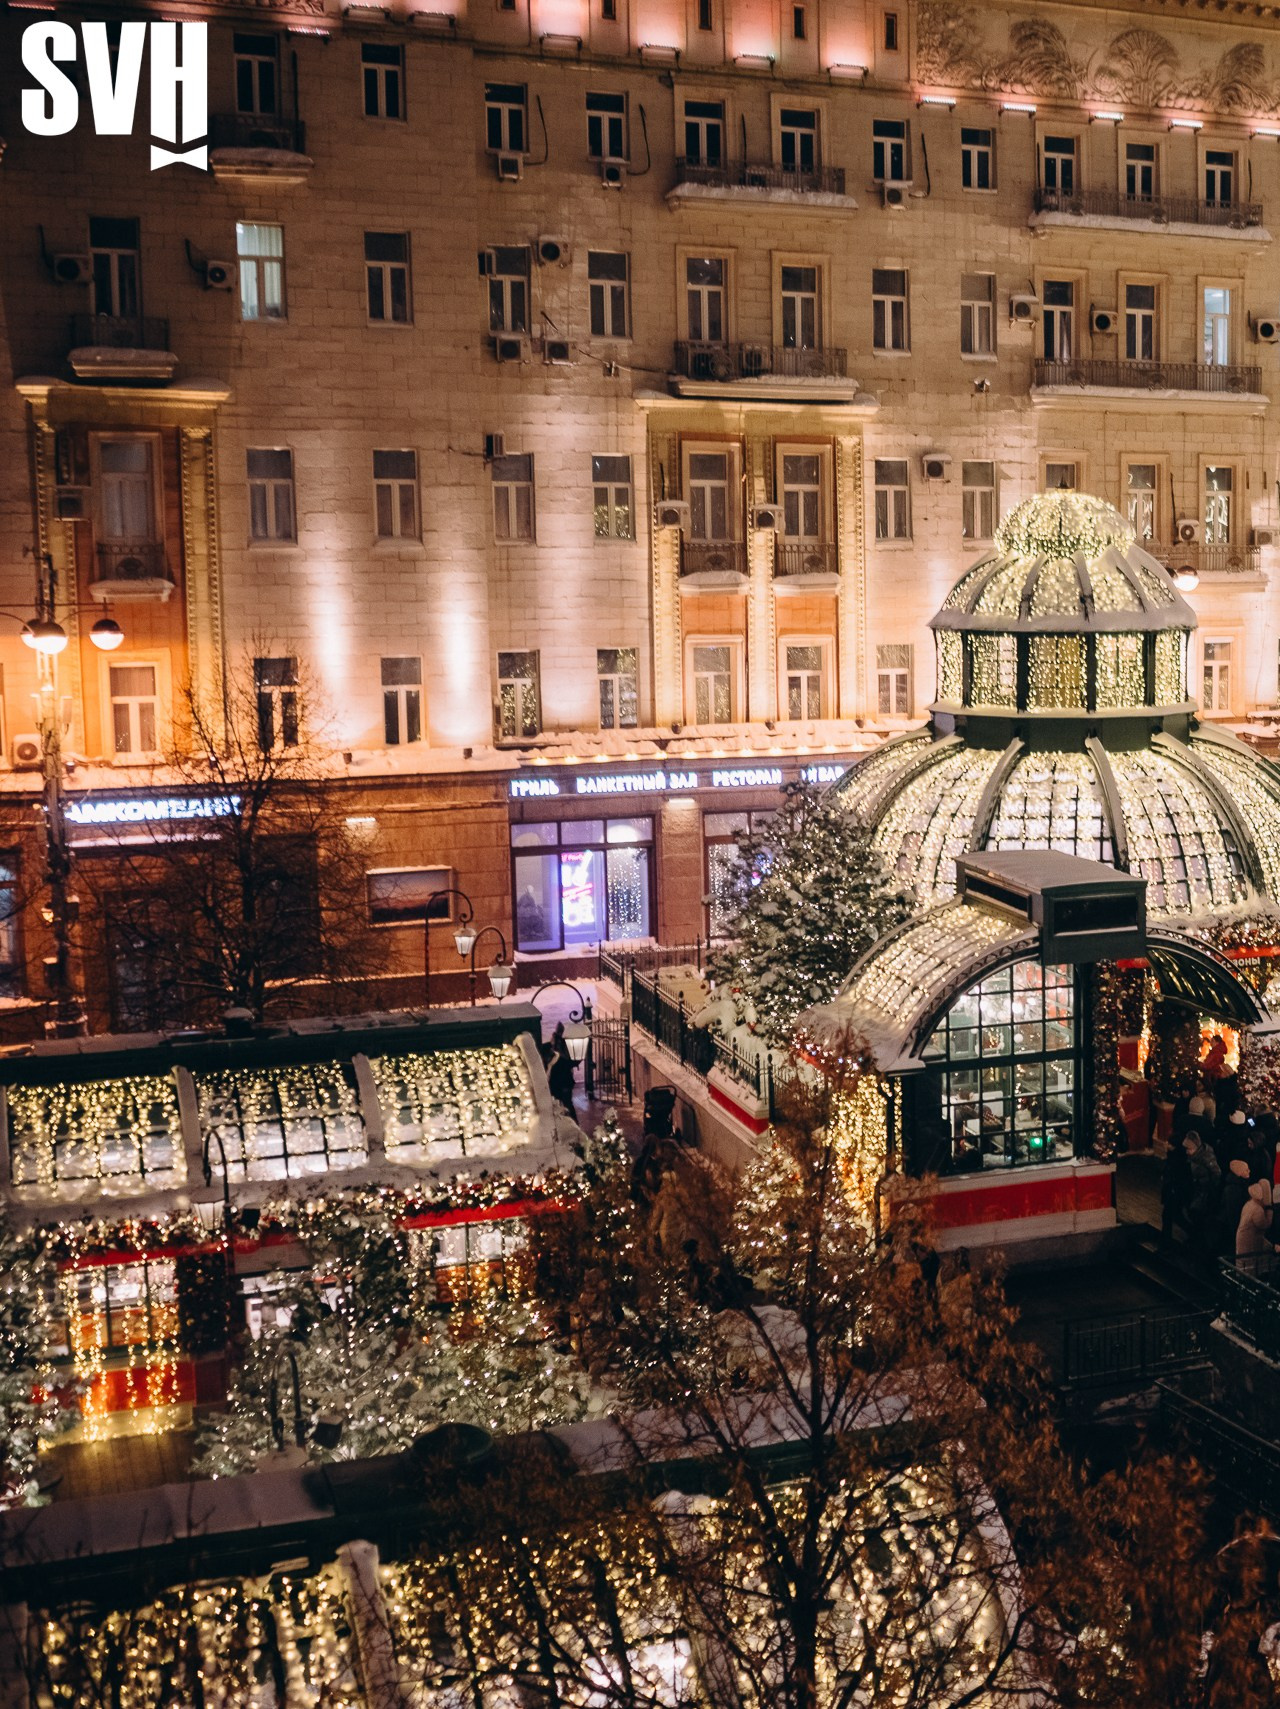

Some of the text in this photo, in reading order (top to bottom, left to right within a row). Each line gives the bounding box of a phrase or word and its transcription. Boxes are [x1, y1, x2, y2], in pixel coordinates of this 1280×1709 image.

[511, 780, 559, 796] ГРИЛЬ
[576, 771, 666, 793] БАНКЕТНЫЙ
[669, 772, 698, 789] ЗАЛ
[712, 768, 782, 787] РЕСТОРАН
